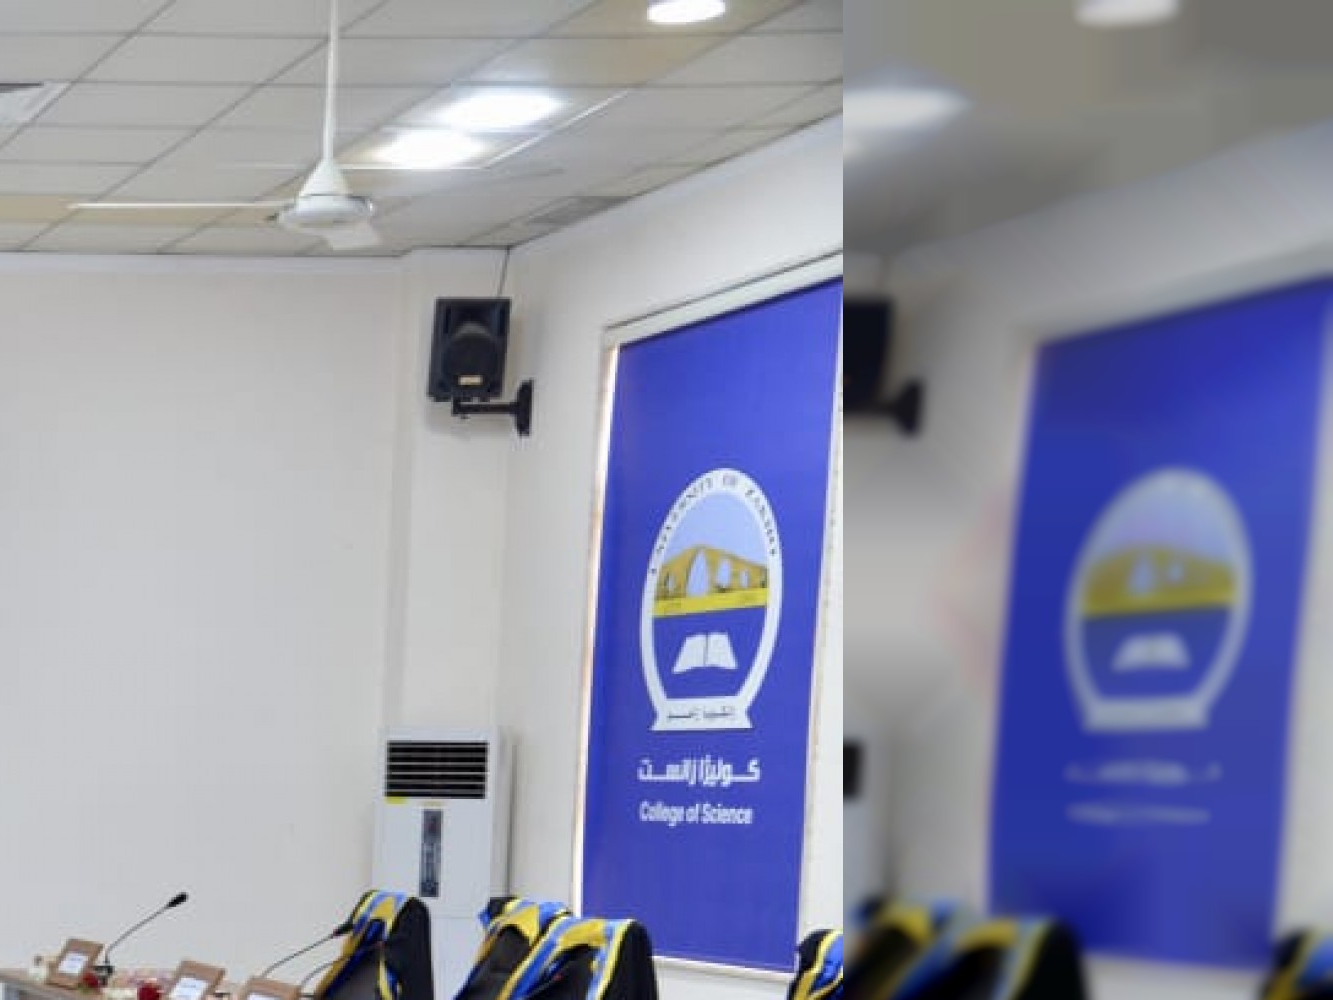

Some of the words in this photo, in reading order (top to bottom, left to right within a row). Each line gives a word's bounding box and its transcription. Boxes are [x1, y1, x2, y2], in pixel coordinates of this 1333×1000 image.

[639, 801, 684, 827] College
[685, 803, 700, 823] of
[702, 803, 753, 824] Science
